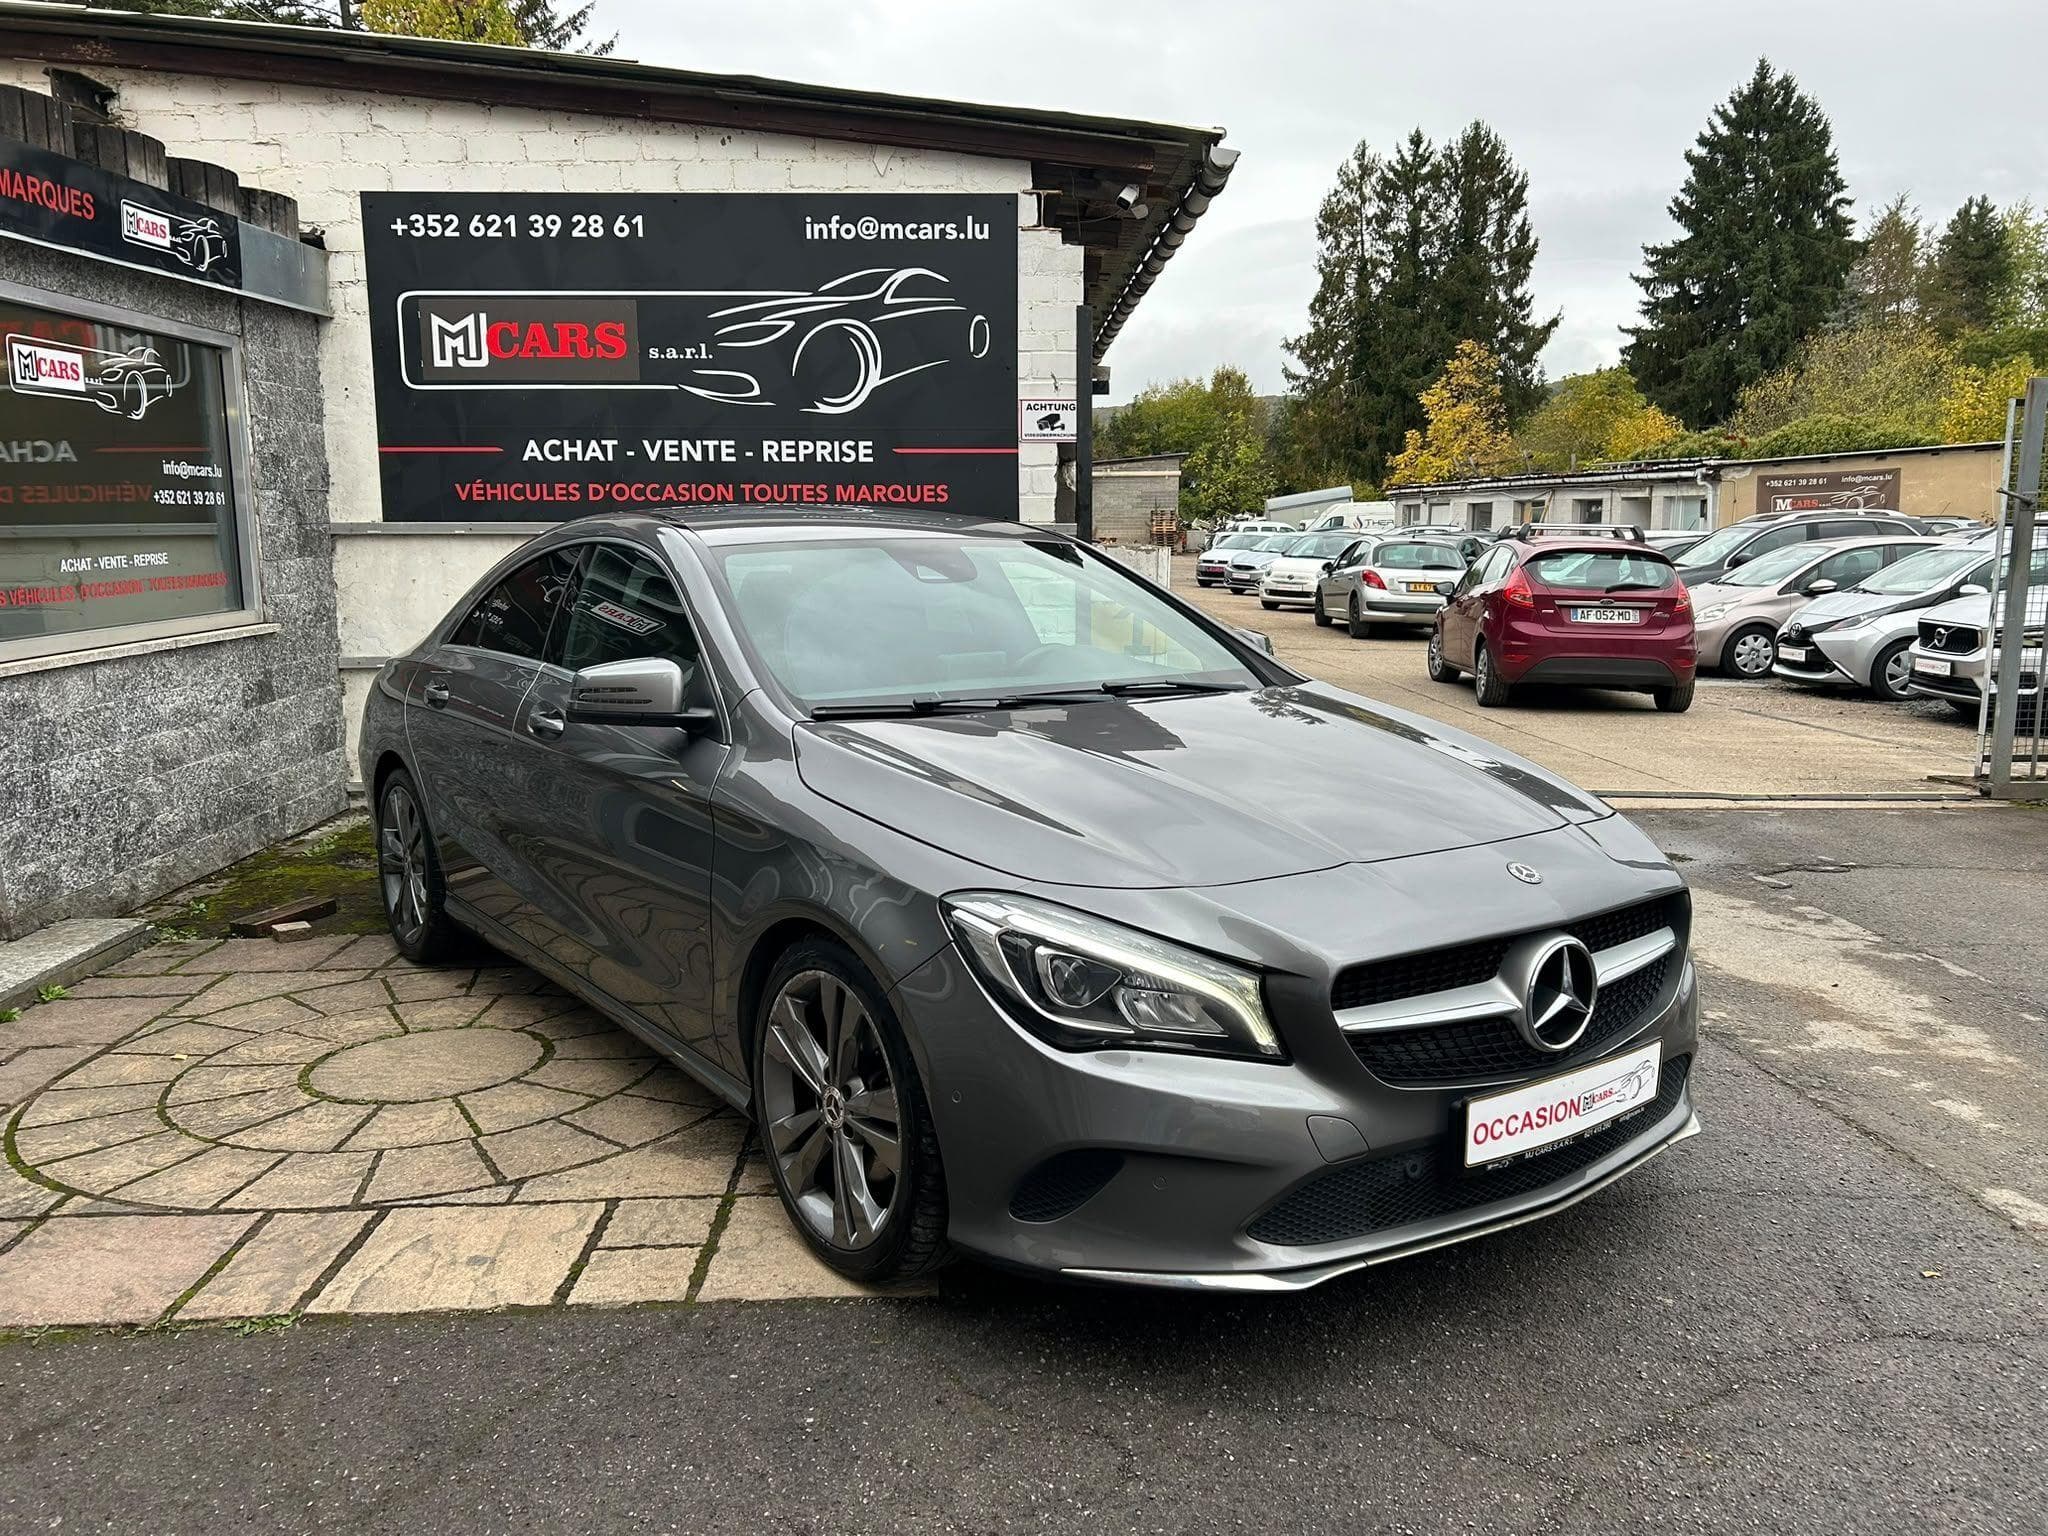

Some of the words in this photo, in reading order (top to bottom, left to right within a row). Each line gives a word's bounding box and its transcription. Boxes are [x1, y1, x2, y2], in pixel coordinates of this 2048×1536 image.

[0, 168, 95, 220] MARQUES
[391, 214, 460, 238] +352
[468, 214, 517, 238] 621
[528, 214, 562, 238] 39
[571, 214, 604, 238] 28
[613, 214, 644, 238] 61
[805, 215, 990, 240] info@mcars.lu
[648, 342, 714, 359] s.a.r.l.
[1026, 403, 1076, 411] ACHTUNG
[522, 440, 618, 462] ACHAT
[643, 440, 736, 462] VENTE
[762, 440, 874, 462] REPRISE
[162, 460, 222, 479] info@mcars.lu
[154, 490, 175, 505] +352
[176, 490, 191, 505] 621
[193, 491, 203, 505] 39
[205, 491, 214, 505] 28
[216, 491, 225, 505] 61
[455, 479, 580, 502] VÉHICULES
[588, 483, 733, 502] D'OCCASION
[741, 484, 828, 502] TOUTES
[836, 485, 949, 503] MARQUES
[60, 558, 92, 572] ACHAT
[99, 555, 128, 570] VENTE
[134, 553, 169, 567] REPRISE
[1473, 1096, 1582, 1145] OCCASION
